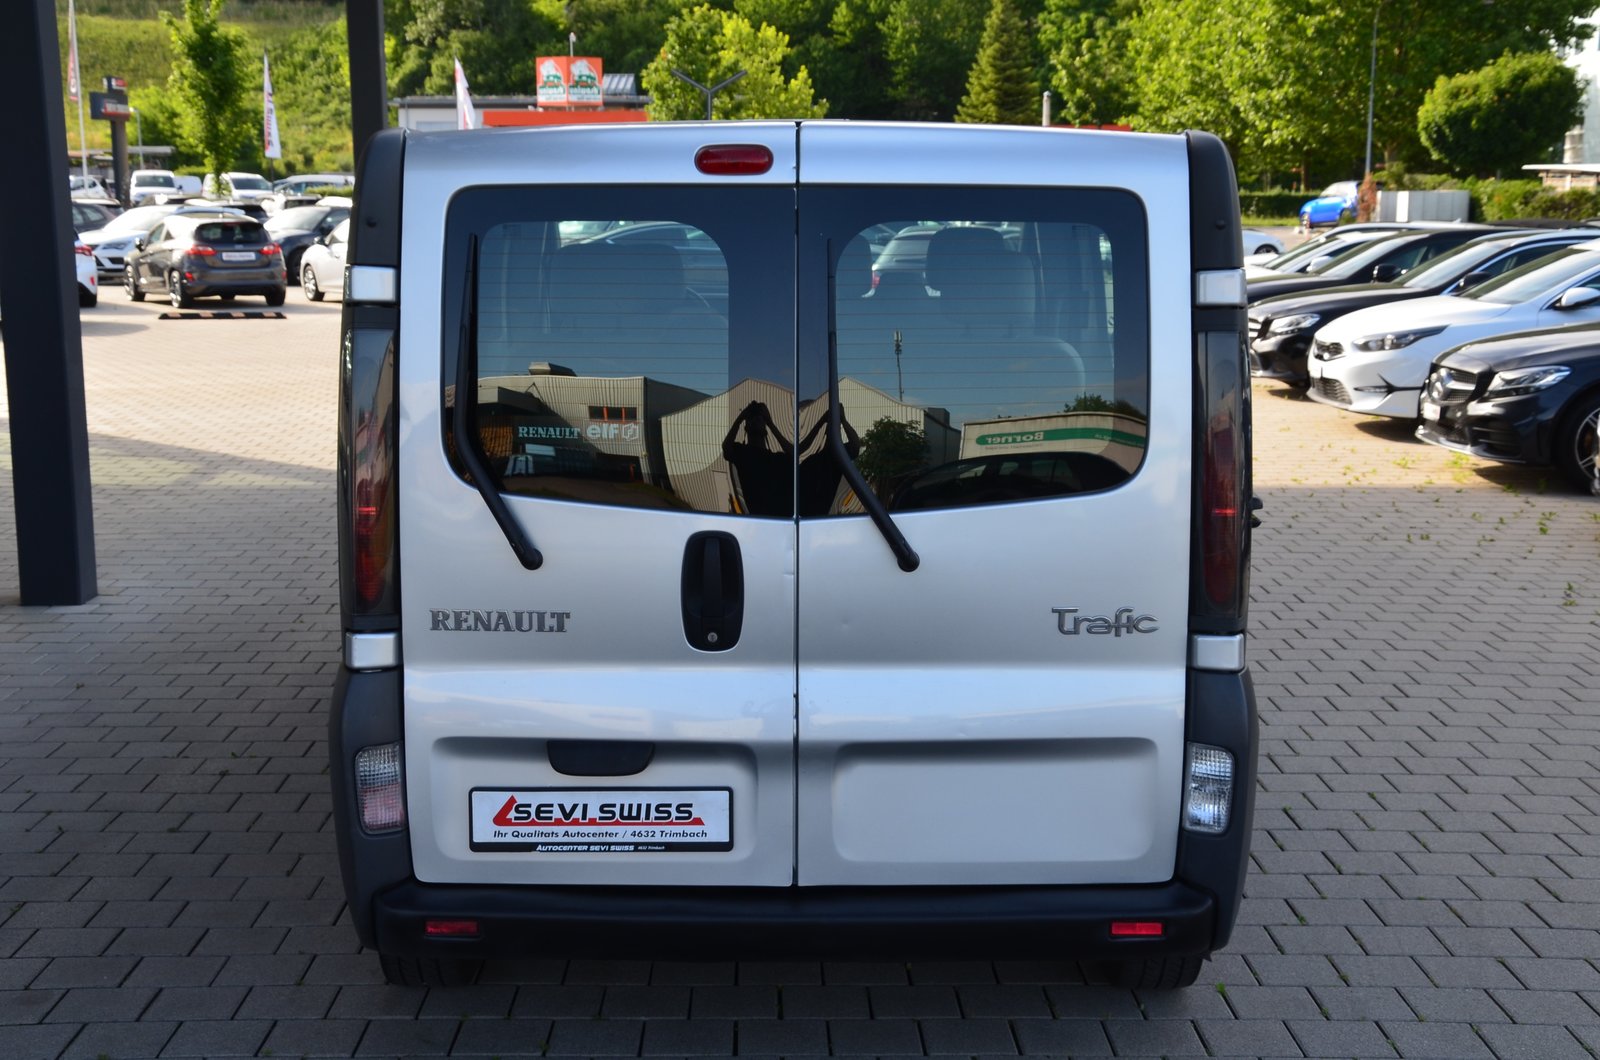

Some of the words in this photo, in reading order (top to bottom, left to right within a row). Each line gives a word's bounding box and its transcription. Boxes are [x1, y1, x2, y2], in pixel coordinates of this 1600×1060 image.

[518, 426, 580, 439] RENAULT
[586, 423, 619, 440] elf
[429, 608, 571, 632] RENAULT
[1051, 606, 1160, 637] Trafic
[513, 802, 589, 822] SEVI
[598, 802, 694, 822] SWISS
[493, 829, 508, 838] Ihr
[562, 830, 619, 838] Autocenter
[630, 830, 656, 838] 4632
[659, 830, 708, 838] Trimbach
